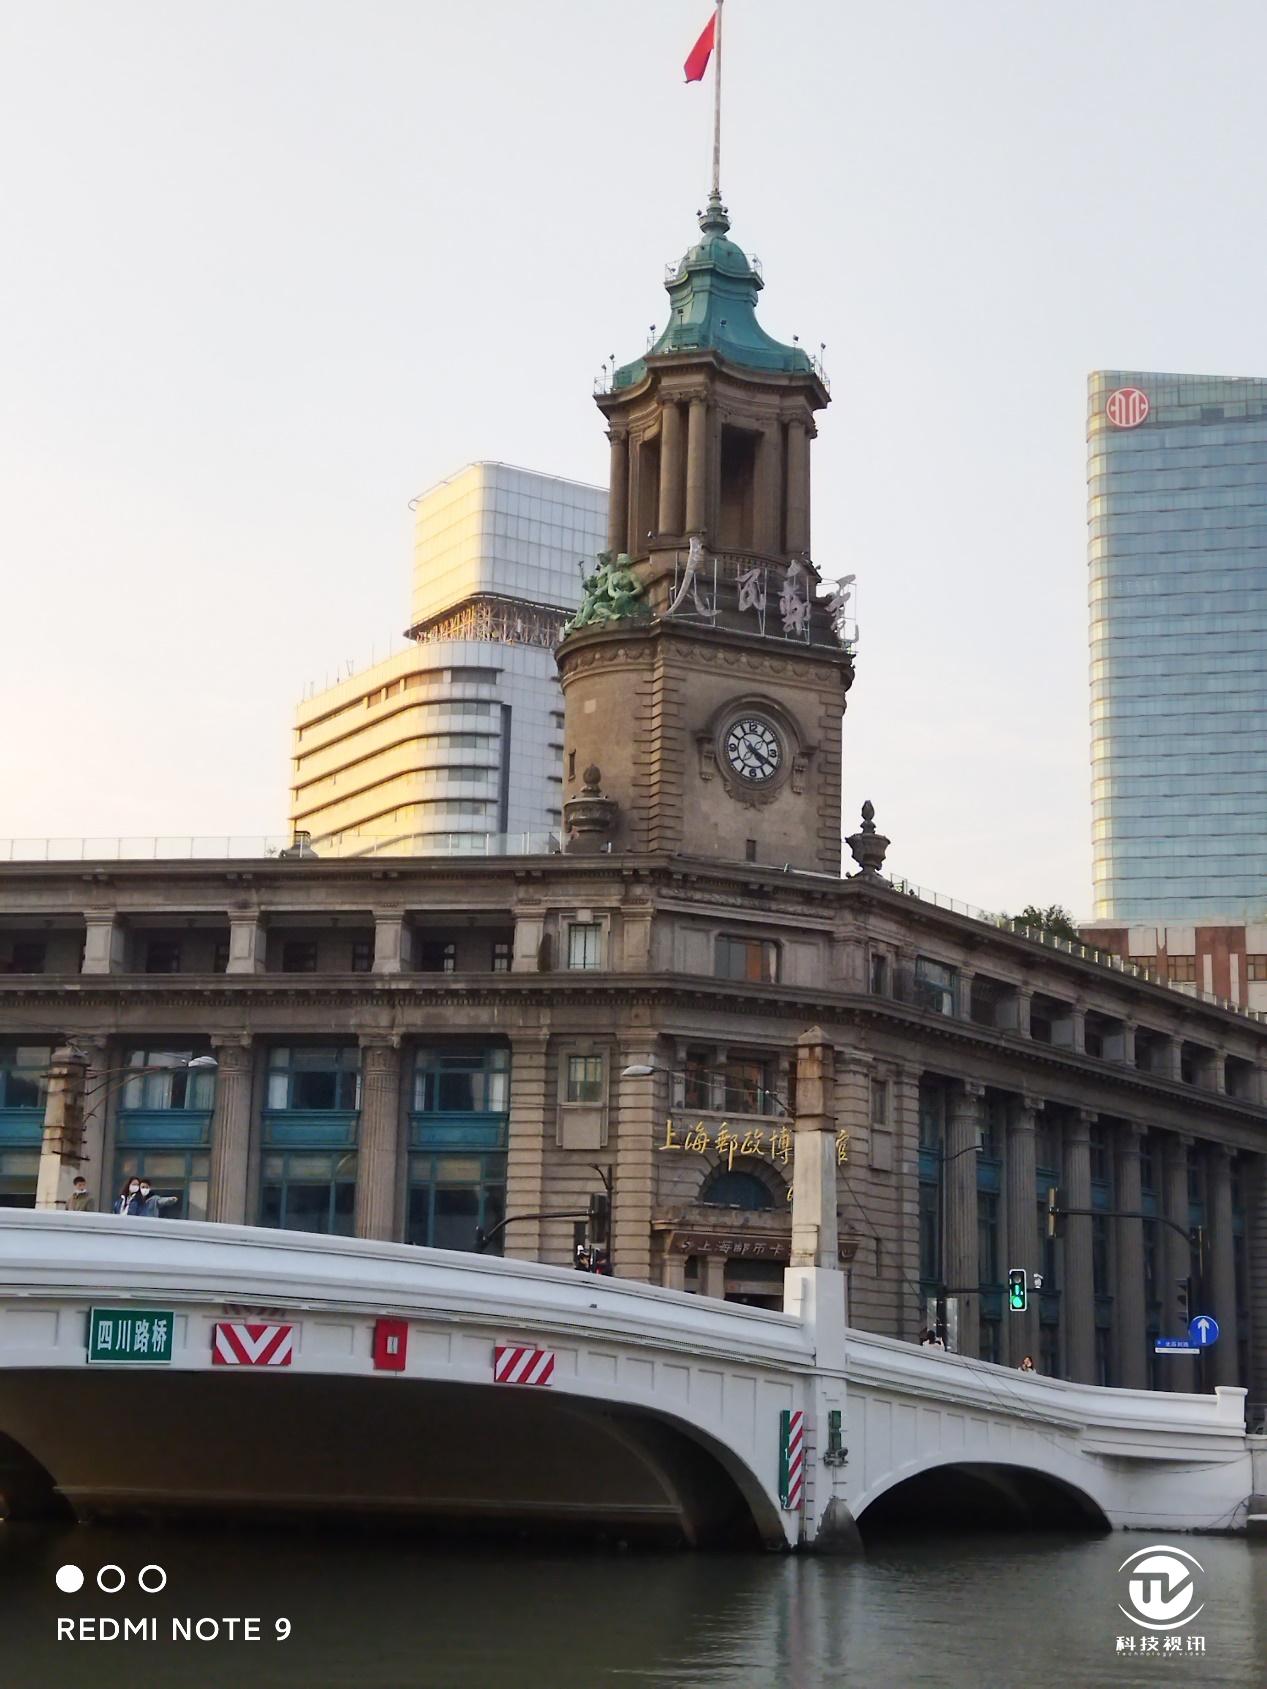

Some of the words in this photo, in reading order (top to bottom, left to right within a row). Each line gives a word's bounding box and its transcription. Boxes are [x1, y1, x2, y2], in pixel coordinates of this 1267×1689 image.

[749, 721, 758, 733] 12
[728, 743, 737, 752] 9
[769, 749, 777, 758] 3
[749, 768, 757, 777] 6
[659, 1119, 850, 1171] 上海郵政博
[97, 1319, 167, 1353] 四川路桥
